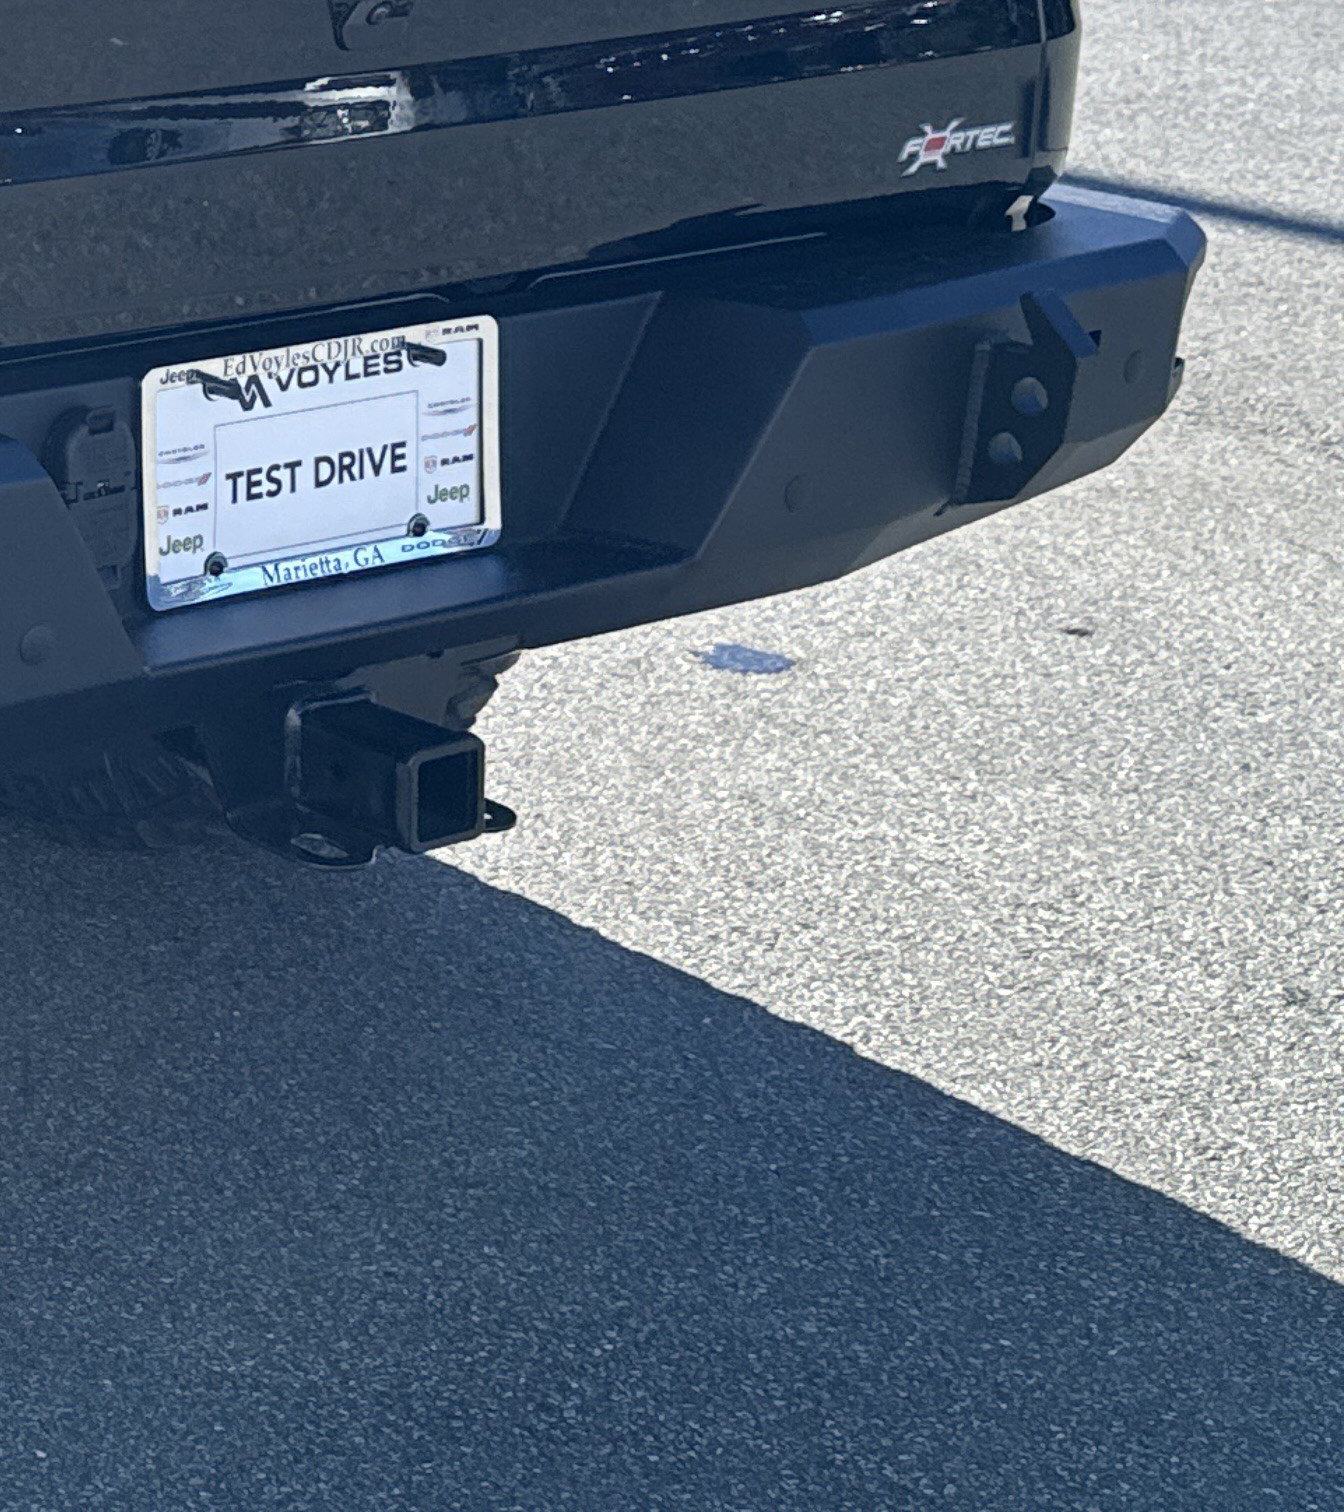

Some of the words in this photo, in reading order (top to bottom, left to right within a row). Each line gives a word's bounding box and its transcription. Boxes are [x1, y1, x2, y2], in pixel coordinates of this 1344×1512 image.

[274, 350, 403, 392] VOYLES
[440, 453, 474, 467] RAM
[225, 459, 303, 505] TEST
[314, 440, 408, 489] DRIVE
[427, 483, 471, 505] Jeep
[172, 502, 209, 517] RAM
[158, 533, 205, 556] Jeep
[262, 554, 349, 586] Marietta,
[353, 544, 386, 568] GA
